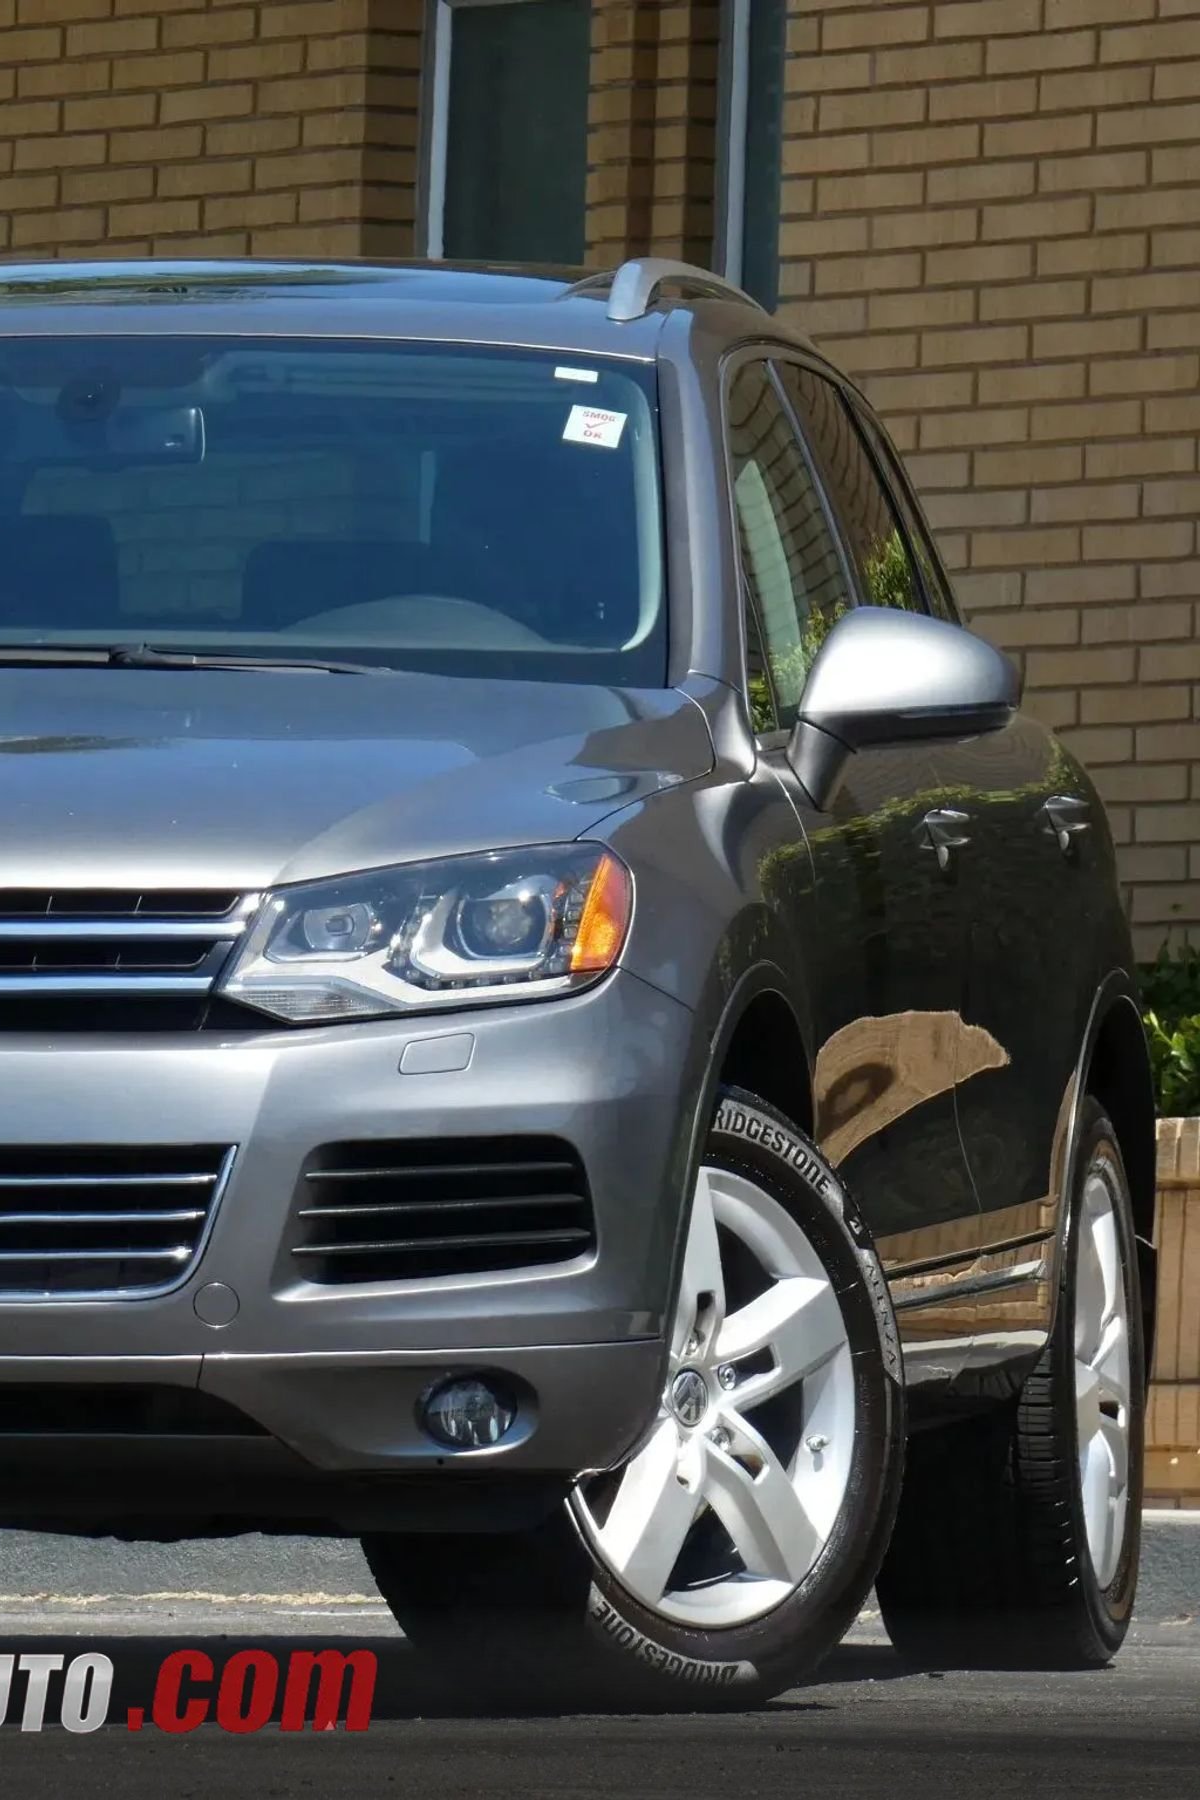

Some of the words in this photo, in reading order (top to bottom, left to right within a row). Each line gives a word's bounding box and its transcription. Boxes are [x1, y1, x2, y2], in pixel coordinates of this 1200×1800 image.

[583, 411, 616, 422] SMOG
[583, 430, 602, 439] OK
[712, 1108, 832, 1195] RIDGESTONE
